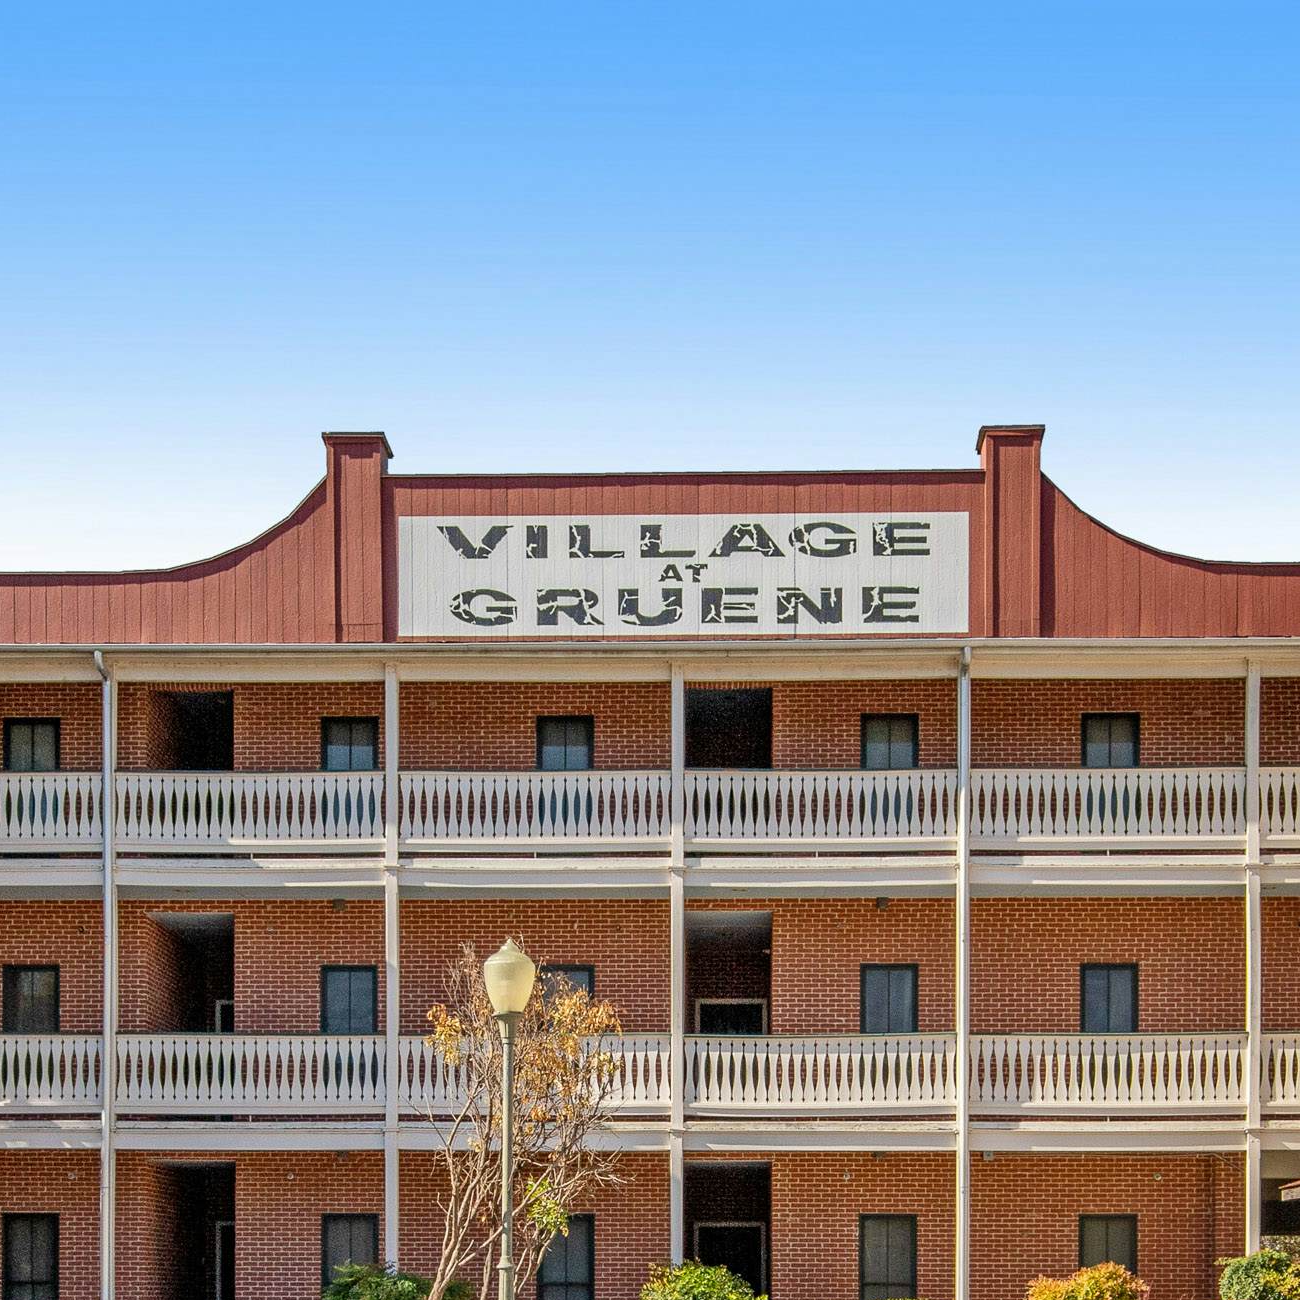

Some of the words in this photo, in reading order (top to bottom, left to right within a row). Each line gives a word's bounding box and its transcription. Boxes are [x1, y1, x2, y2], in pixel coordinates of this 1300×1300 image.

[437, 521, 931, 559] VILLAGE
[659, 564, 708, 583] AT
[451, 587, 921, 625] GRUENE
